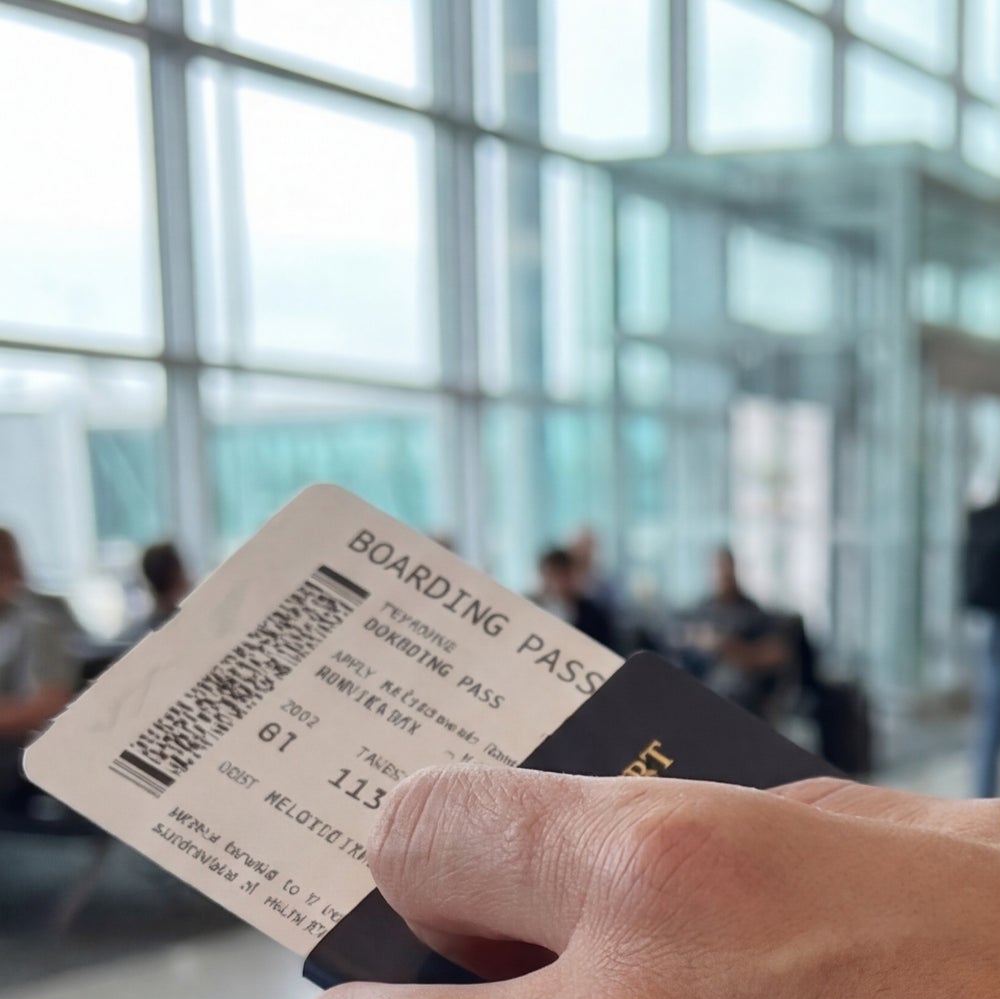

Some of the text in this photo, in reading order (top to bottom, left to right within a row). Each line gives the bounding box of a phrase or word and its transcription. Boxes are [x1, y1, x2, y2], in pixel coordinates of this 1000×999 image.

[348, 528, 604, 696] BOARDING PASS
[457, 675, 505, 711] PASS
[327, 767, 388, 810] 113
